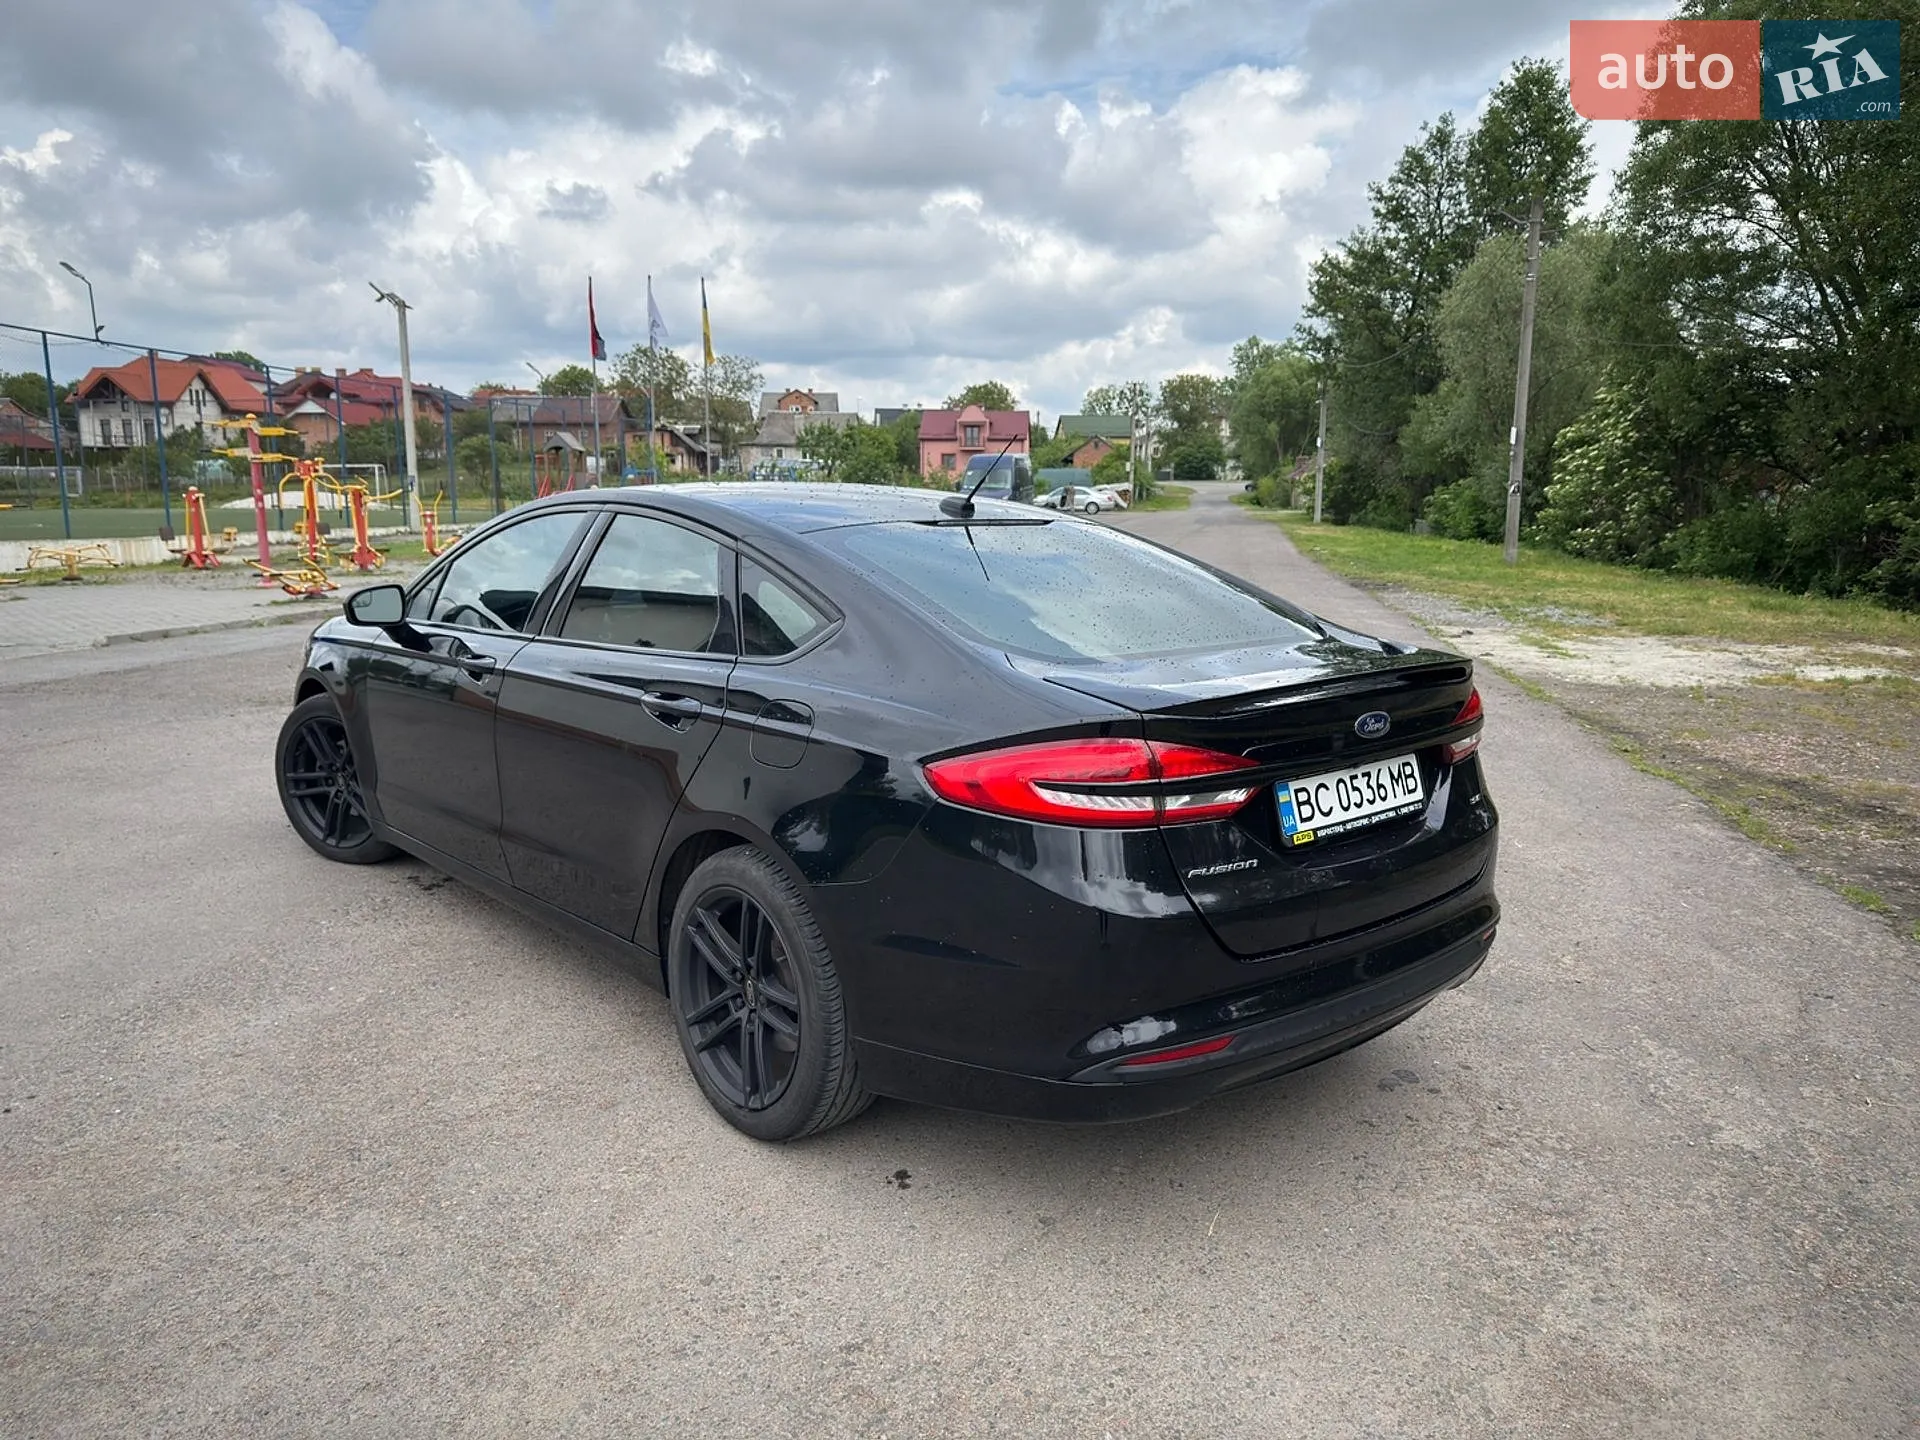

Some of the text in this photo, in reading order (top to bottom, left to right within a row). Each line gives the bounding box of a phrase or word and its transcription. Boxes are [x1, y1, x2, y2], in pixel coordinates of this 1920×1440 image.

[1293, 782, 1334, 824] BC
[1335, 768, 1388, 812] 0536
[1387, 761, 1418, 799] MB
[1283, 815, 1296, 828] UA
[1187, 858, 1259, 879] FUSION
